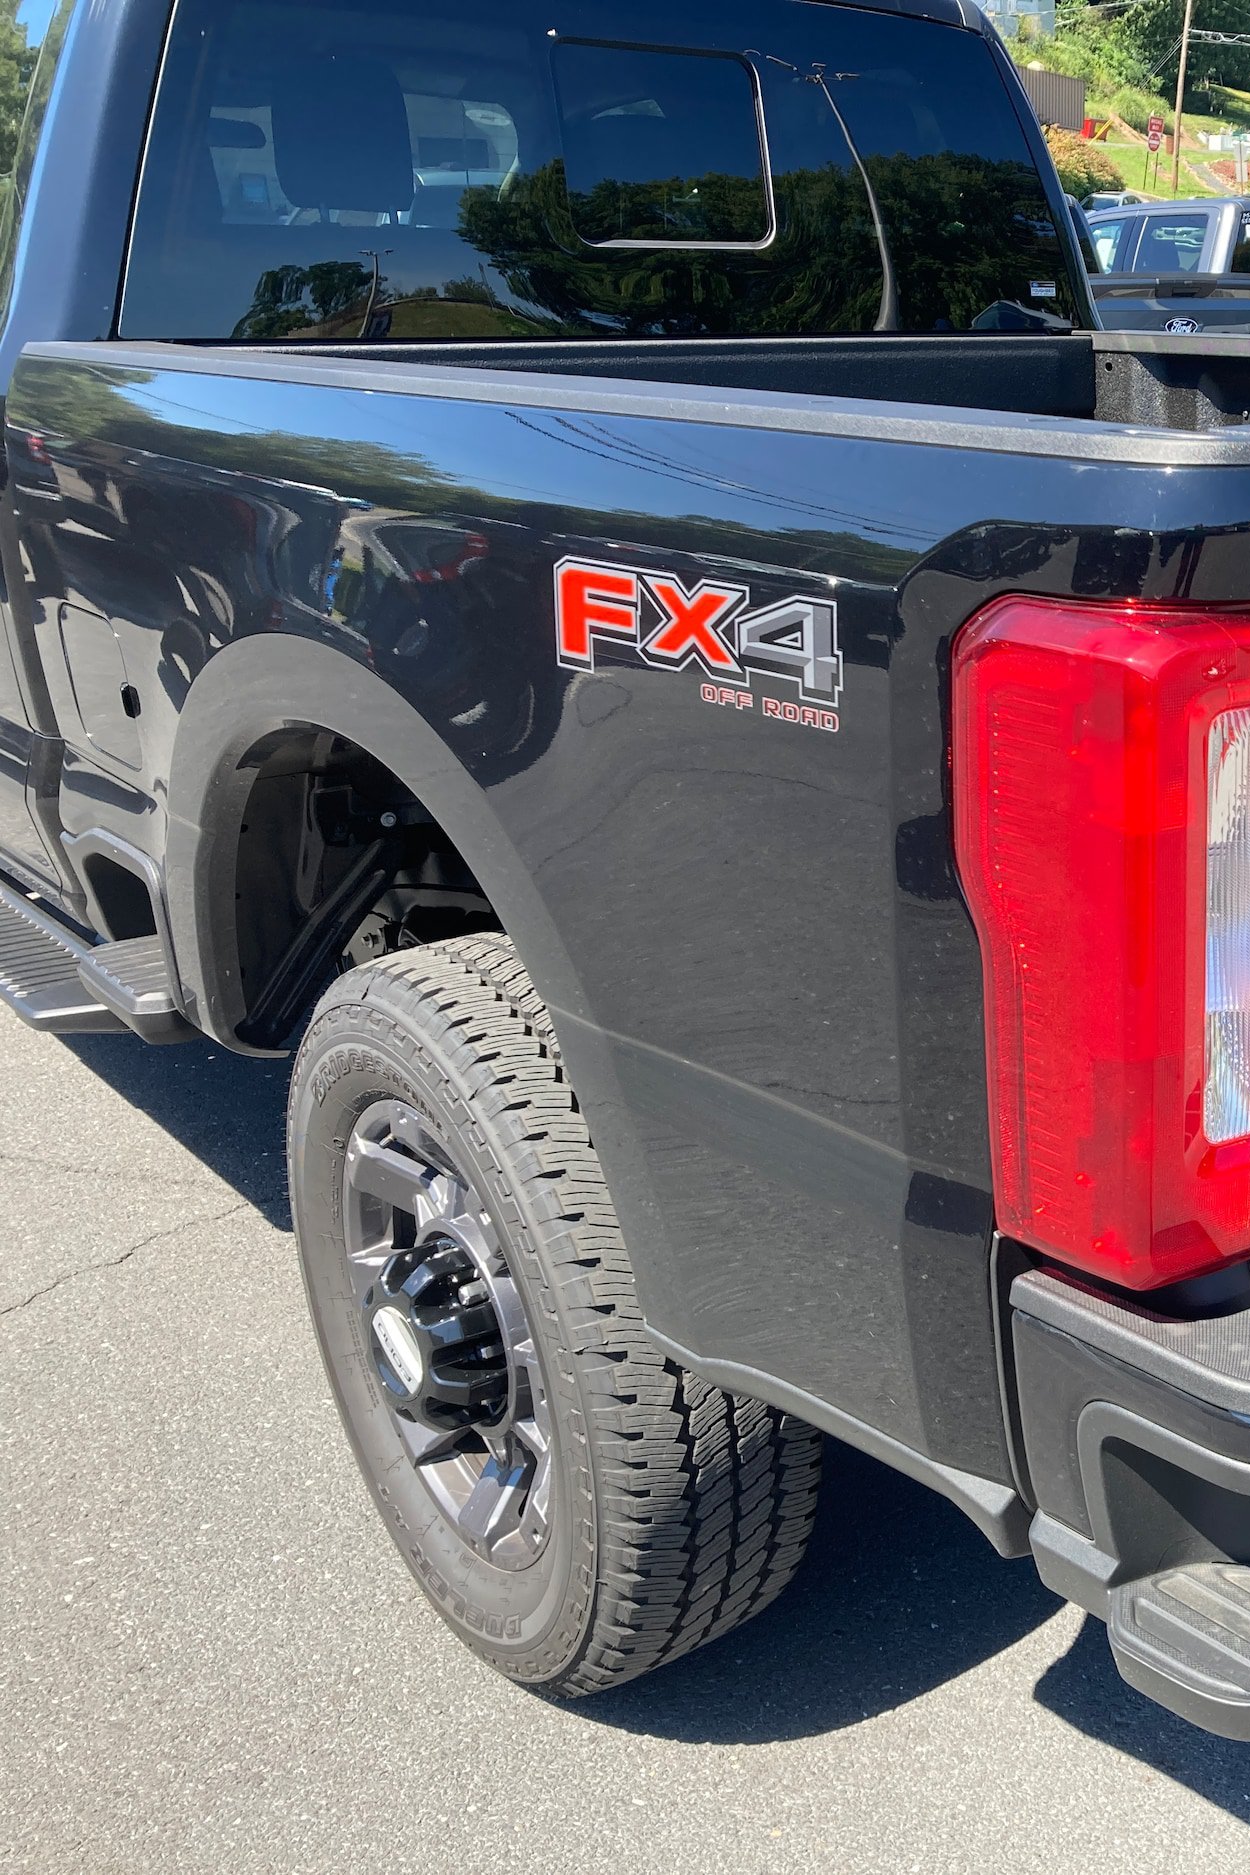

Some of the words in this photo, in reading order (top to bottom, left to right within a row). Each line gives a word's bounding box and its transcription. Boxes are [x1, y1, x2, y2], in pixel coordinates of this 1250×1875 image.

[553, 555, 843, 707] FX4
[700, 683, 753, 709] OFF
[762, 696, 839, 732] ROAD
